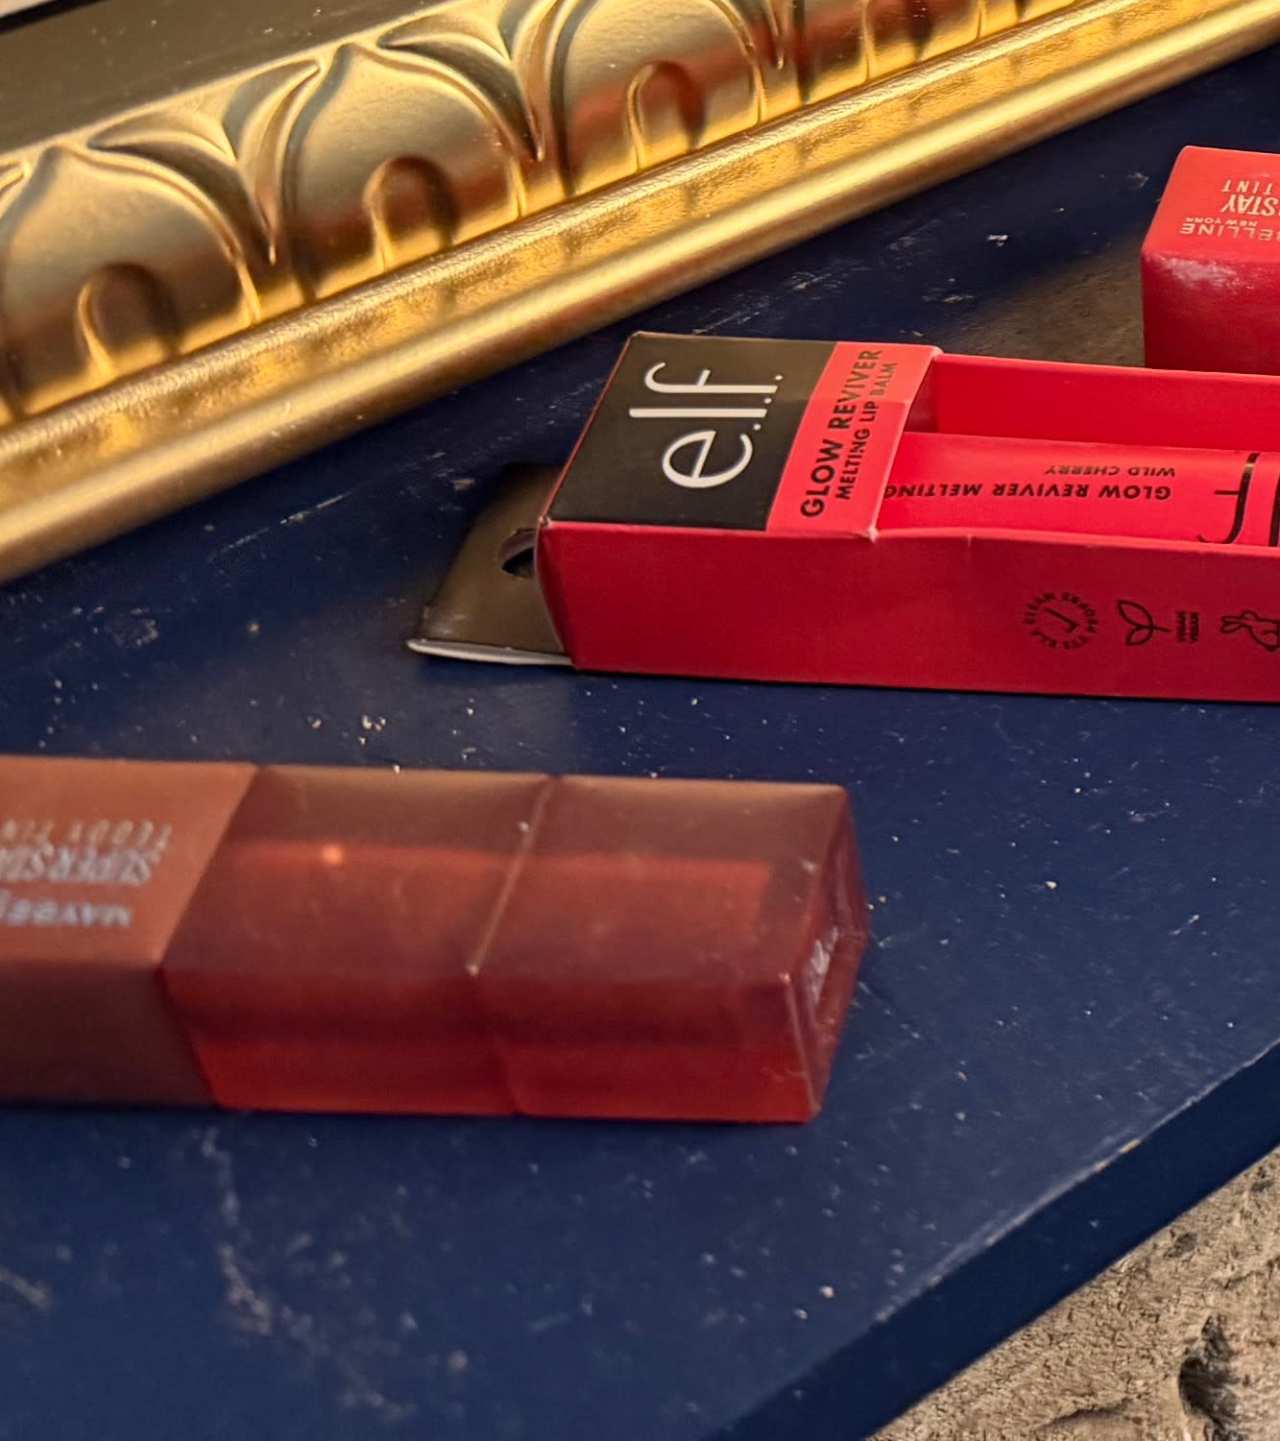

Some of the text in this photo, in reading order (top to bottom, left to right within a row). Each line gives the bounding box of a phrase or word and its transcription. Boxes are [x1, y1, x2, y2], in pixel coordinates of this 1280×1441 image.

[1221, 179, 1273, 195] TINT
[1185, 217, 1258, 227] NEW YORK
[800, 350, 882, 517] GLOW REVIVER
[835, 363, 898, 500] MELTING LIP BALM
[1045, 465, 1176, 477] WILD CHERRY
[884, 483, 1171, 501] GLOW REVIVER MELTING
